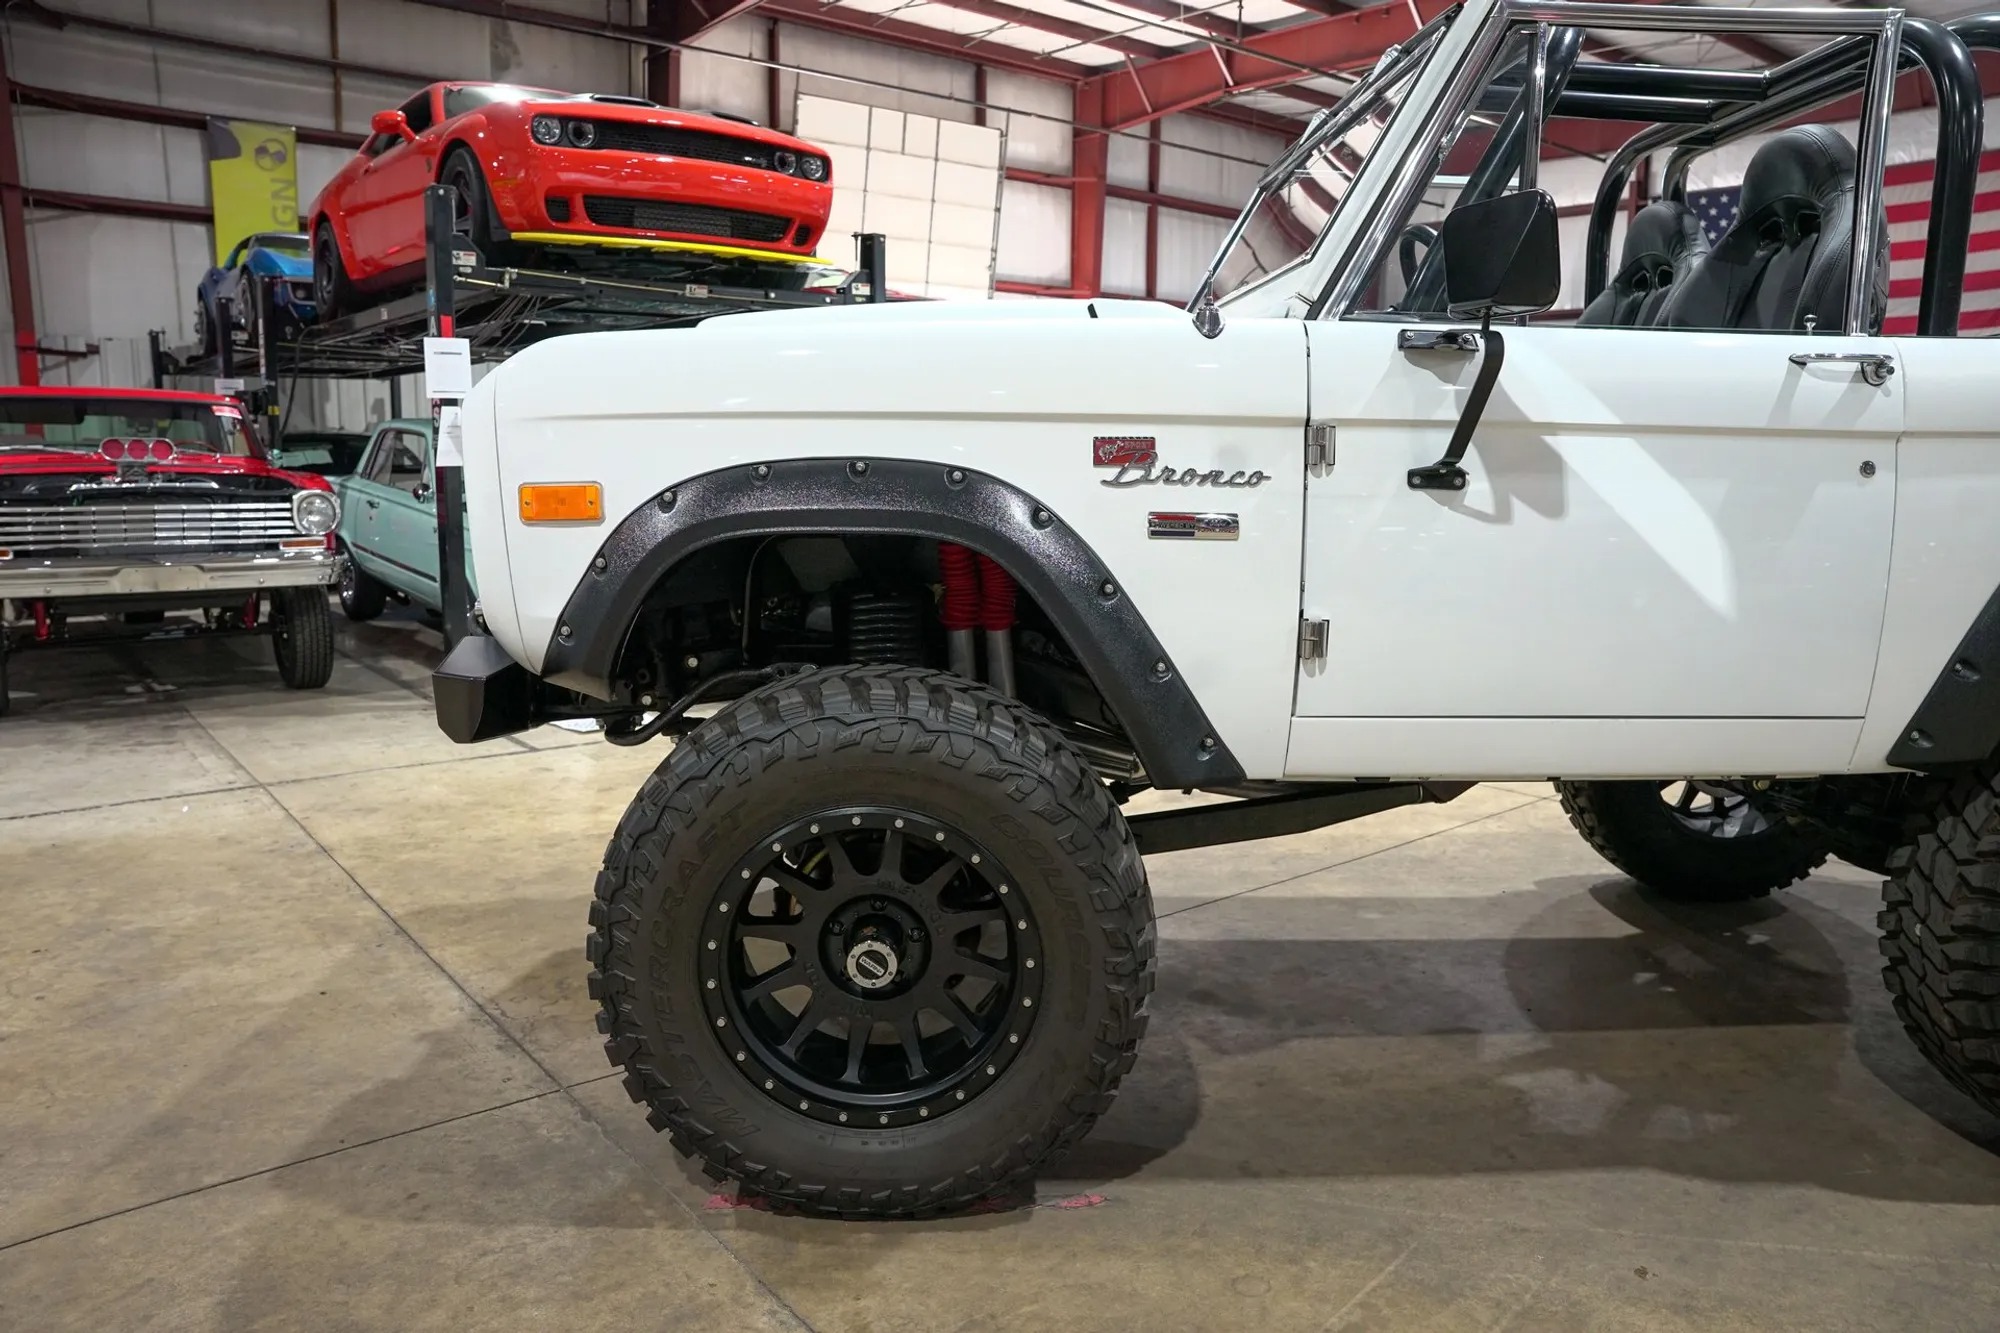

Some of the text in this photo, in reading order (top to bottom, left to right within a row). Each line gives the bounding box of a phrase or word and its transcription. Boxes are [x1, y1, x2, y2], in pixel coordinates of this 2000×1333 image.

[270, 177, 297, 232] GN
[1100, 450, 1272, 488] Bronco
[648, 799, 760, 1136] MASTERCRAFT
[860, 957, 883, 974] WARN
